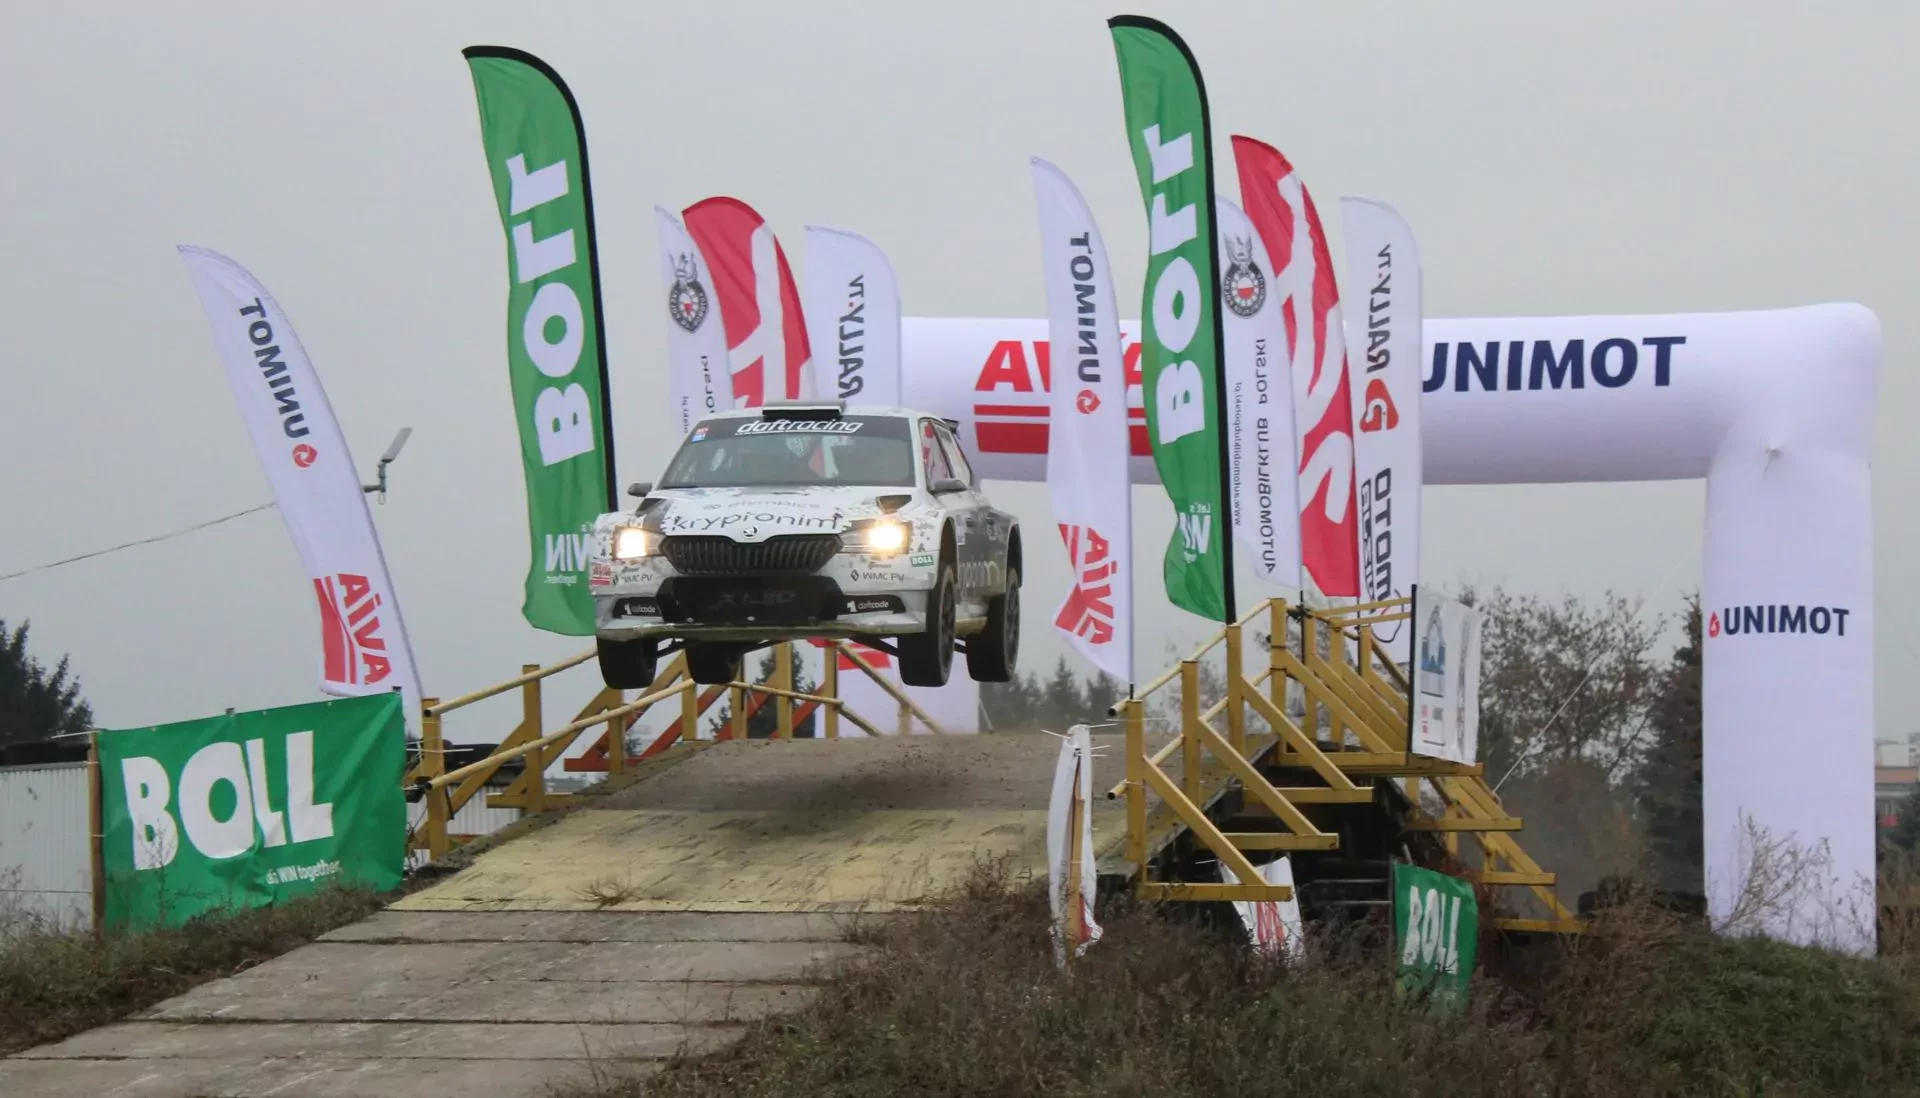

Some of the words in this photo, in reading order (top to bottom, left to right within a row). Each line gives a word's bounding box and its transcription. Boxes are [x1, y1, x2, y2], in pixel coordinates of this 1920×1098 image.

[736, 418, 865, 434] daftracing
[1723, 604, 1850, 637] UNIMOT
[121, 730, 334, 871] BOLL
[1402, 885, 1461, 975] BOLL
